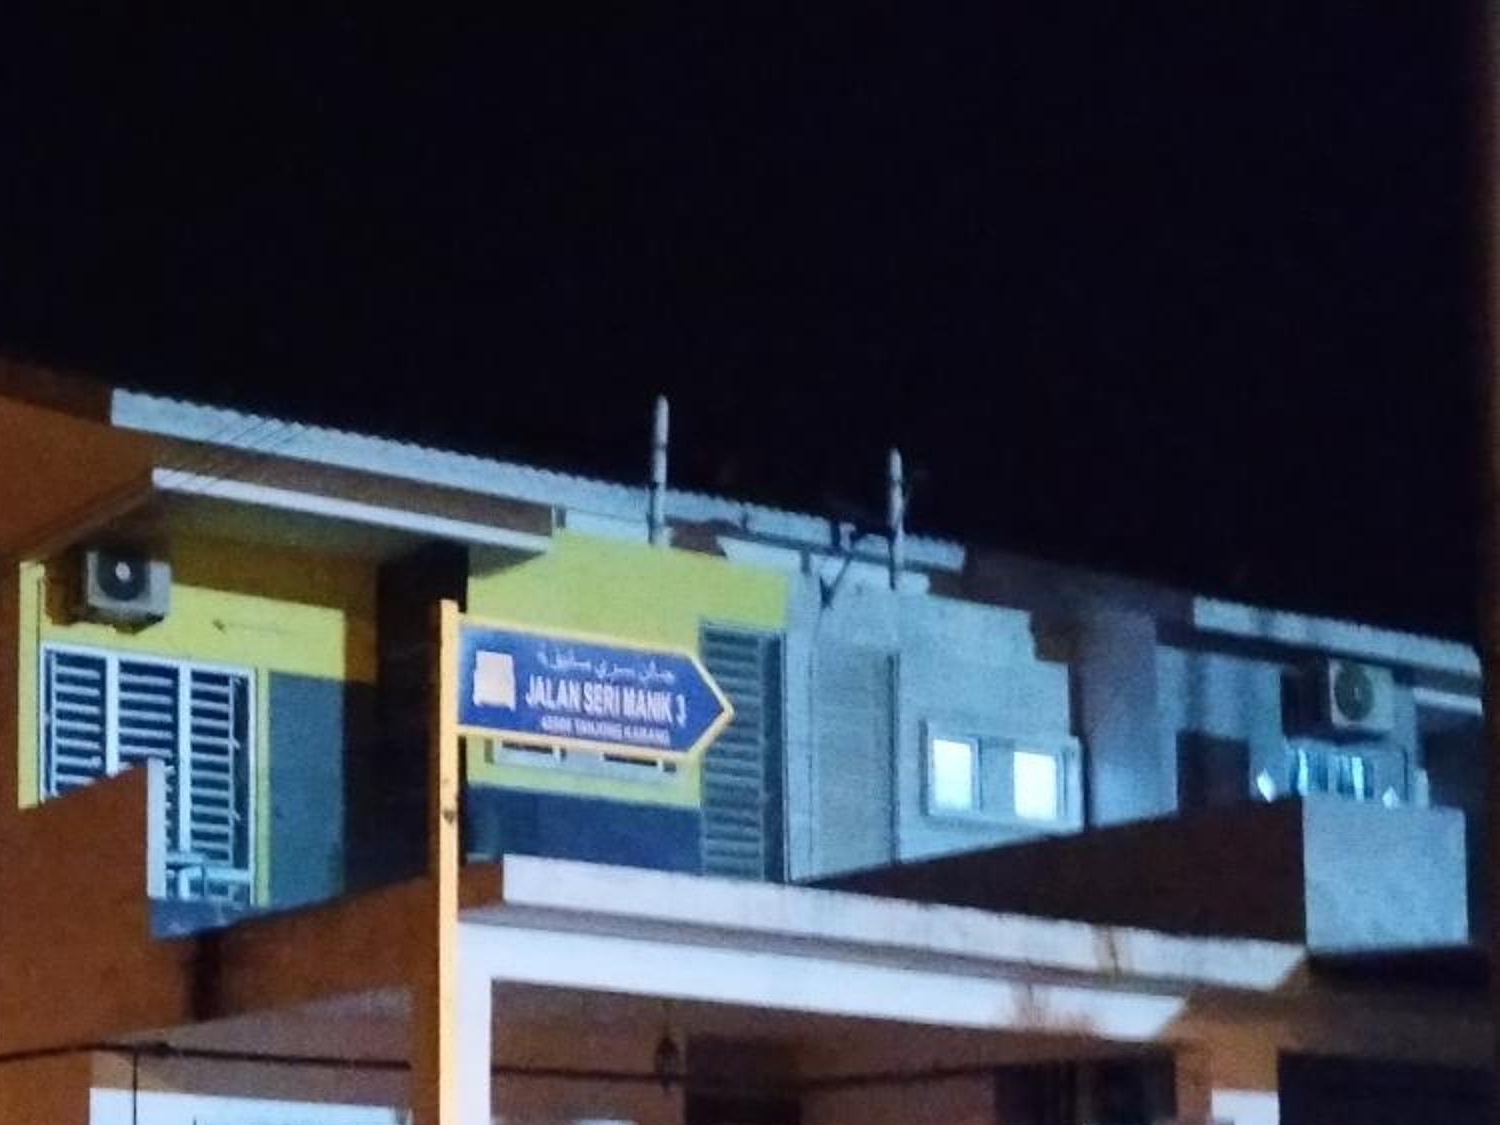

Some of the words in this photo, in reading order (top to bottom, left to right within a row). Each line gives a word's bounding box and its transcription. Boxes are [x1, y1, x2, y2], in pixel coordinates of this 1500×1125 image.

[525, 674, 582, 713] JALAN
[582, 680, 620, 720] SERI
[621, 685, 672, 724] MANIK
